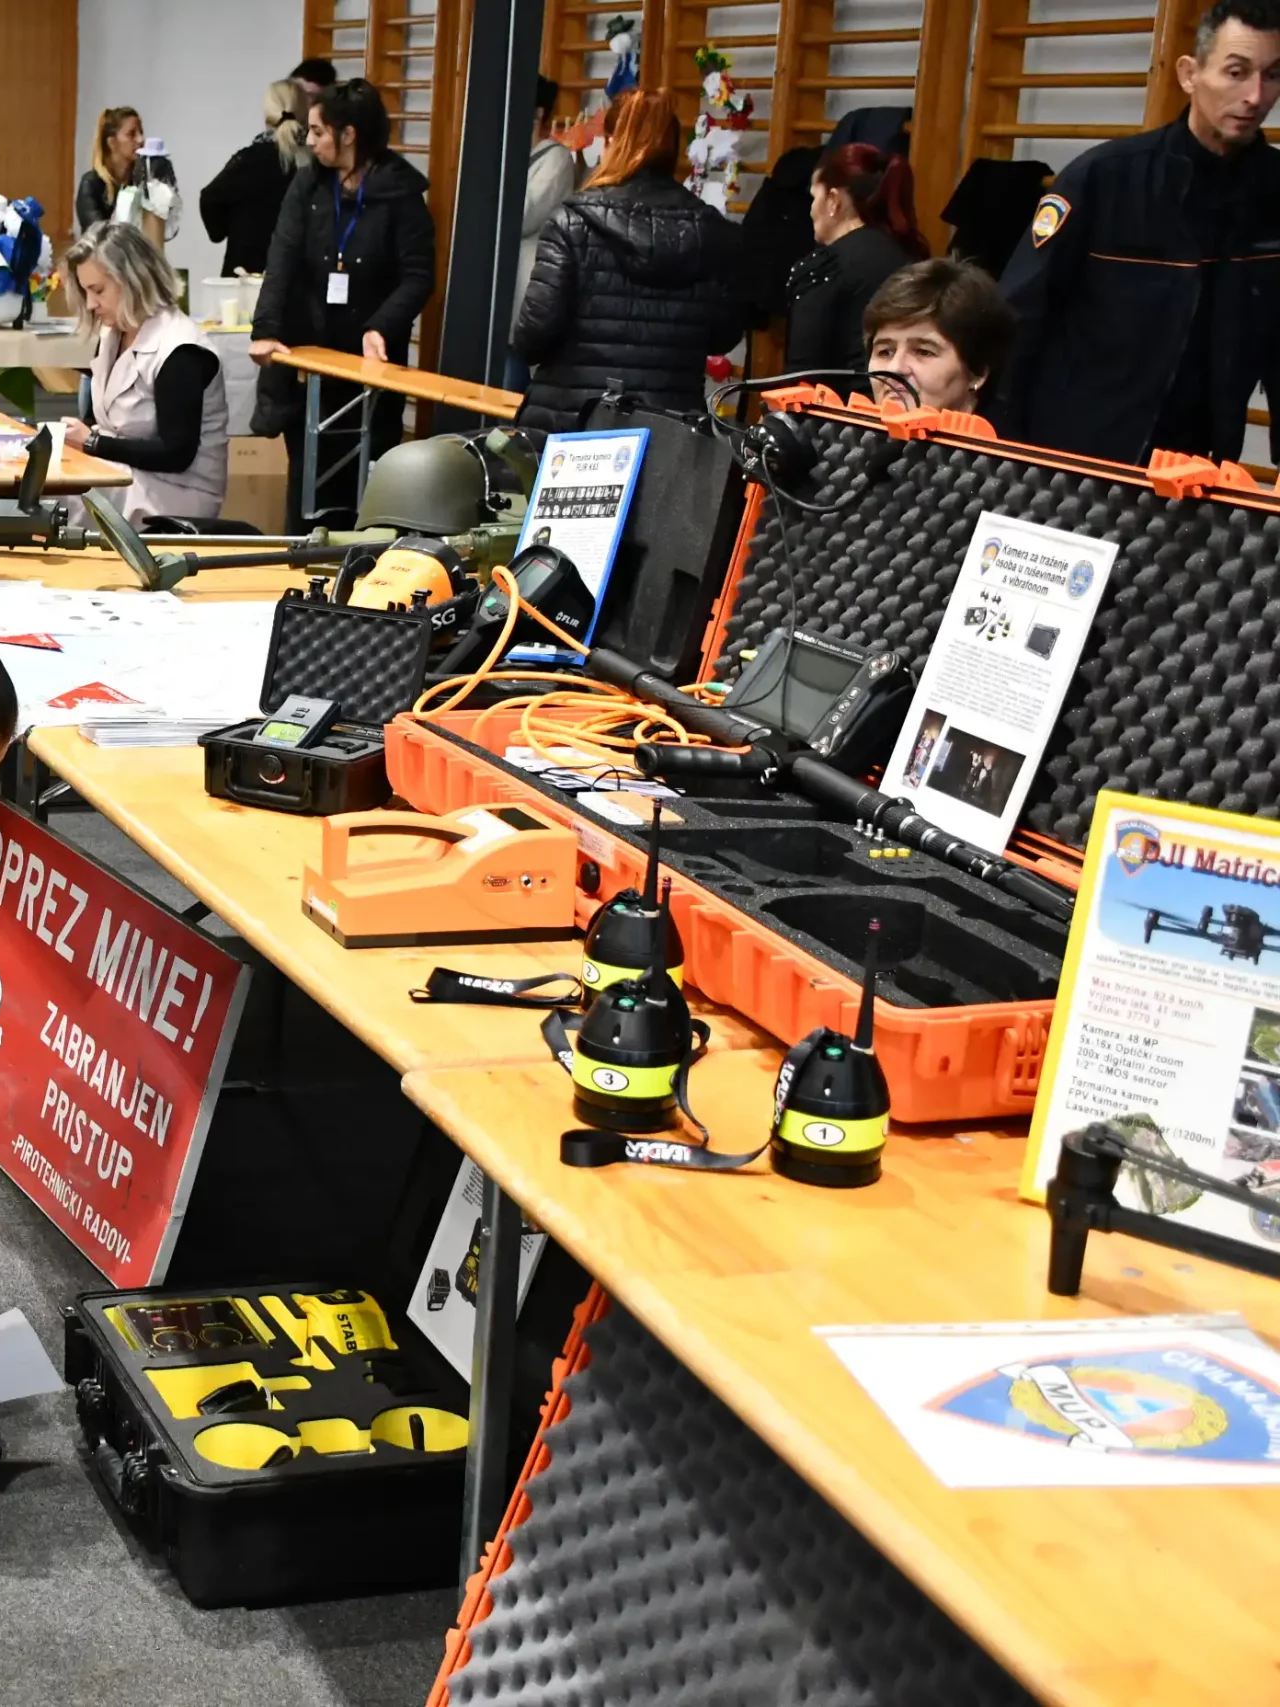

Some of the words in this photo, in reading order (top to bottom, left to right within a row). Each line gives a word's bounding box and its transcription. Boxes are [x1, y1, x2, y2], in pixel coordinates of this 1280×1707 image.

[995, 558, 1018, 572] osoba
[1023, 565, 1066, 586] ruševinama
[1002, 543, 1029, 560] Kamera
[1029, 552, 1039, 563] za
[1039, 553, 1069, 573] traženje
[1009, 576, 1049, 596] vibrafonom
[560, 613, 580, 628] FLIR
[1143, 837, 1186, 870] DJI
[1191, 847, 1280, 889] Matric
[87, 907, 214, 1054] MINE!
[1115, 1042, 1153, 1061] Optički
[1155, 1055, 1184, 1068] zoom
[1127, 1033, 1140, 1044] 48
[1142, 1036, 1159, 1047] MP
[40, 1000, 174, 1148] ZABRANJEN
[1077, 1046, 1100, 1060] 200x
[1103, 1052, 1146, 1072] digitalni
[1148, 1065, 1177, 1079] zoom
[1097, 1063, 1130, 1080] CMOS
[1132, 1073, 1169, 1089] senzor
[605, 1073, 613, 1085] 3
[1071, 1075, 1118, 1096] Termalna
[1121, 1088, 1160, 1106] kamera
[1068, 1087, 1090, 1100] FPV
[1092, 1094, 1130, 1111] kamera
[40, 1078, 134, 1190] PRISTUP
[1065, 1101, 1110, 1118] Laserski
[1173, 1127, 1216, 1148] (1200m)
[337, 1313, 358, 1353] STAB
[1041, 1382, 1107, 1430] MUP
